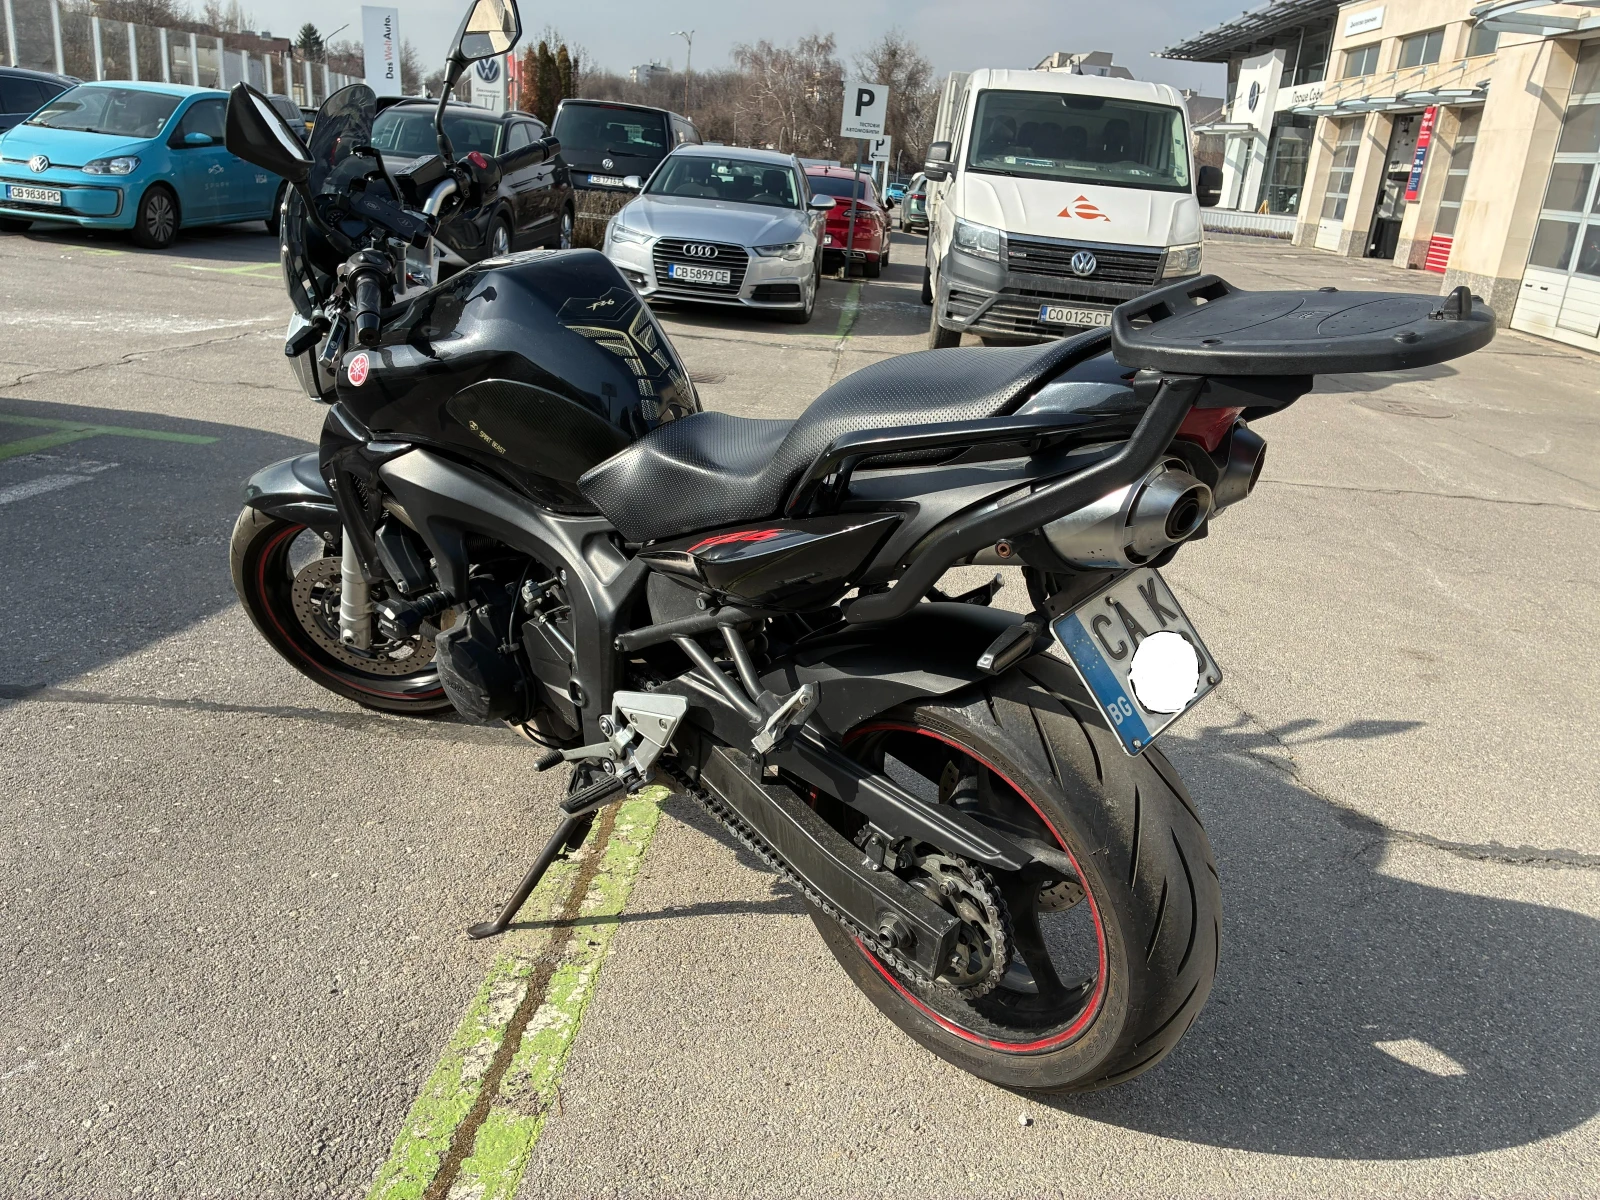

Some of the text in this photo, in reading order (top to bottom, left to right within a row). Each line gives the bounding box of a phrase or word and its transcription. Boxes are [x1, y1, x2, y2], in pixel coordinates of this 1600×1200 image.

[383, 15, 394, 80] Das WeltAuto.
[855, 88, 875, 116] P
[11, 187, 24, 198] CB
[24, 188, 46, 200] 9838
[675, 266, 729, 283] CB 5899 CE
[1065, 310, 1093, 324] 0125
[1094, 313, 1111, 326] CT
[491, 441, 507, 455] BEAST
[1106, 696, 1133, 725] BG
